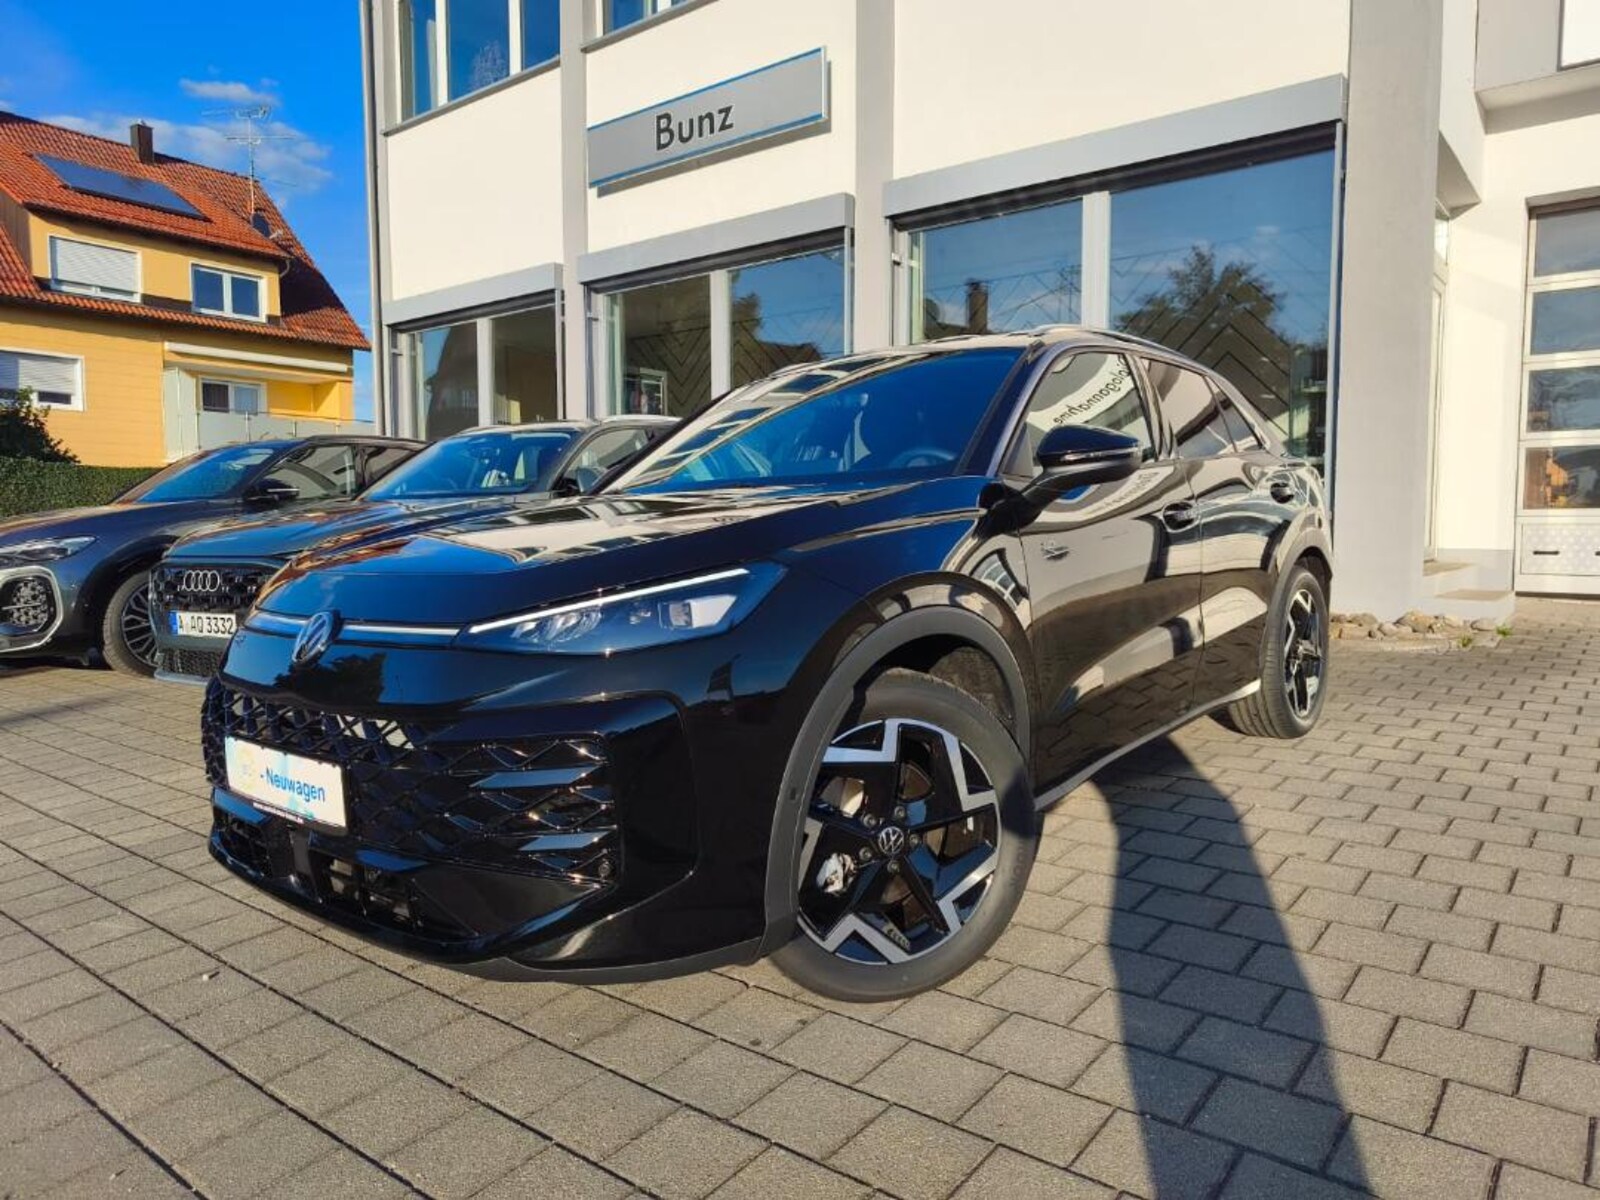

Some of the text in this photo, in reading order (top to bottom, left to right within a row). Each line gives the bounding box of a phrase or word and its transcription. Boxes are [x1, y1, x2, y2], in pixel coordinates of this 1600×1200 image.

[655, 105, 734, 151] Bunz
[205, 616, 234, 635] 3332
[266, 766, 326, 803] Neuwagen
